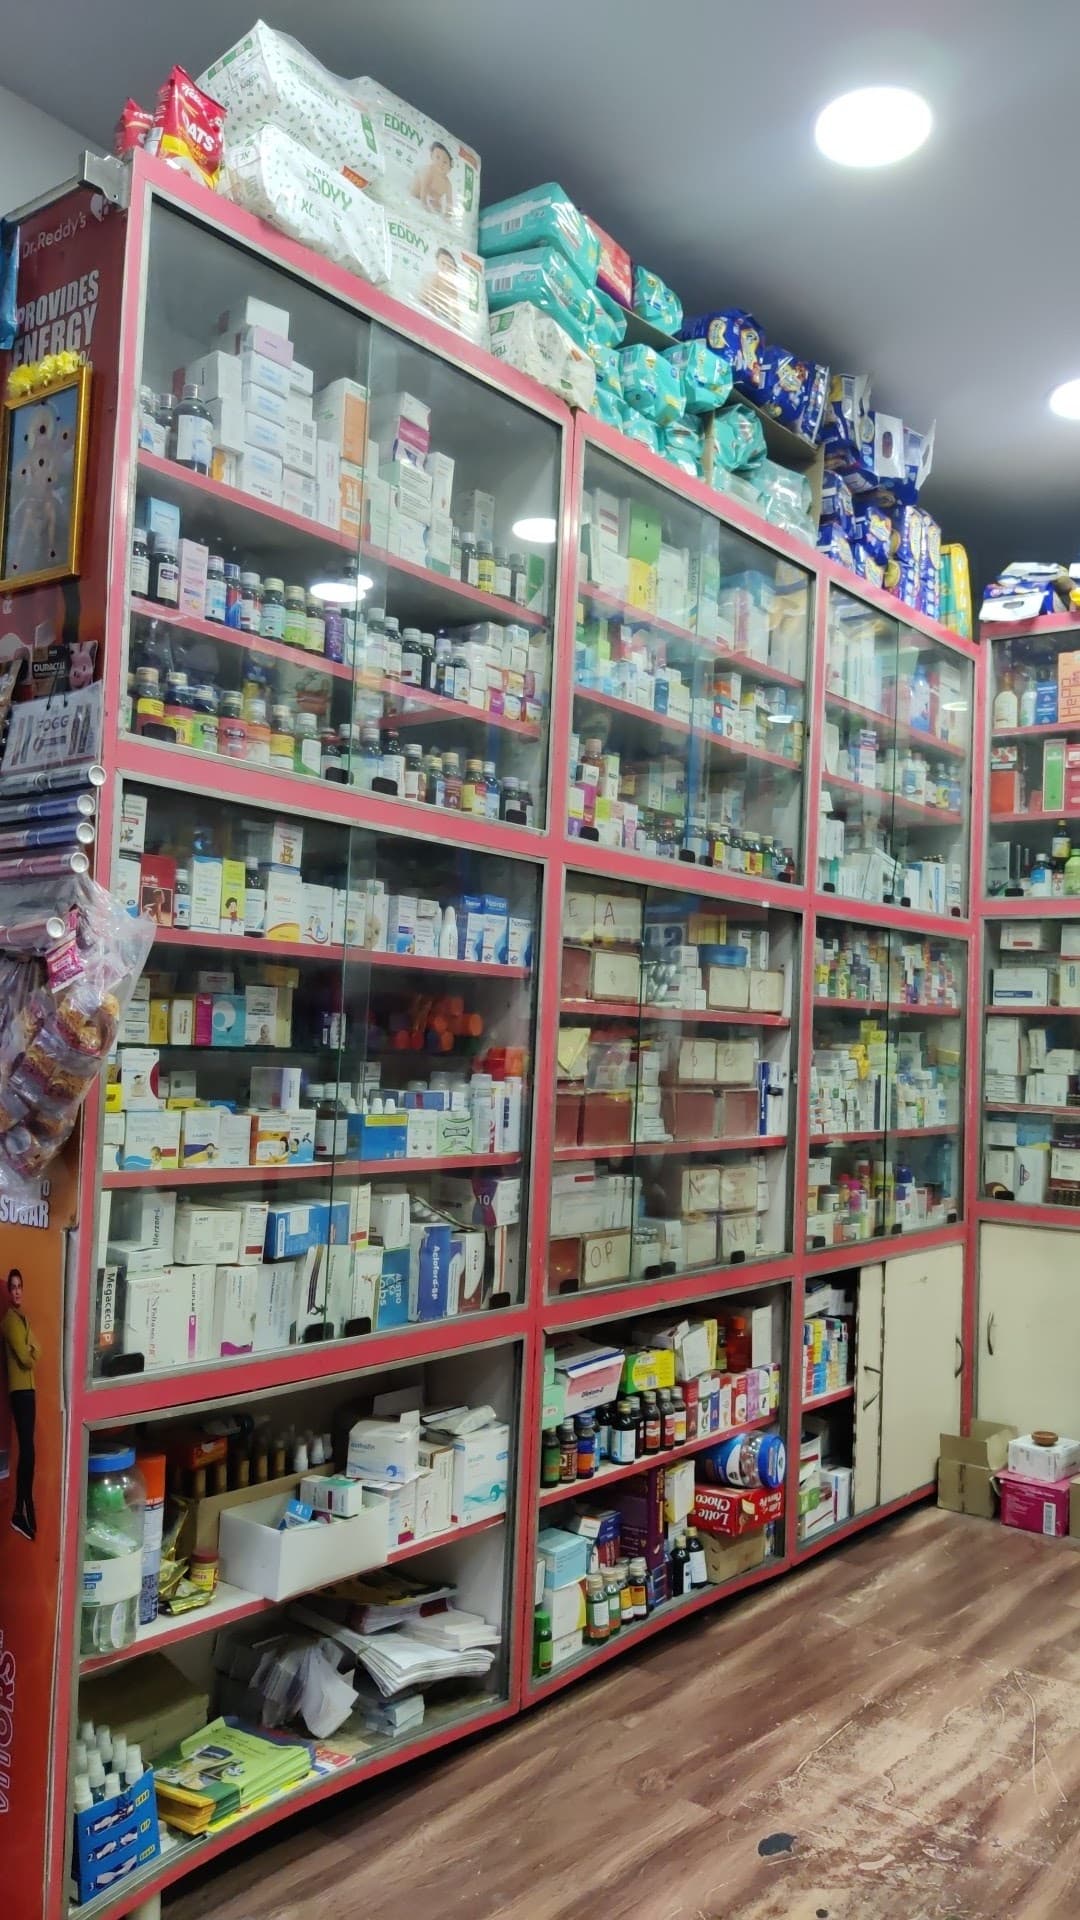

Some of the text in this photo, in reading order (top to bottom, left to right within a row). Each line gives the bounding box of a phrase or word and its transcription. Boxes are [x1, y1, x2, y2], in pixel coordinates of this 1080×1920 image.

[181, 110, 215, 152] OATS
[384, 112, 424, 147] EDDYY
[17, 269, 99, 333] PROVIDES
[14, 304, 97, 367] ENERGY
[38, 714, 70, 732] FOGG
[603, 901, 616, 927] A
[0, 1194, 50, 1228] SUGAR
[103, 1272, 117, 1345] Megaceclo P
[695, 1494, 731, 1512] Choco
[698, 1508, 729, 1526] Lotte
